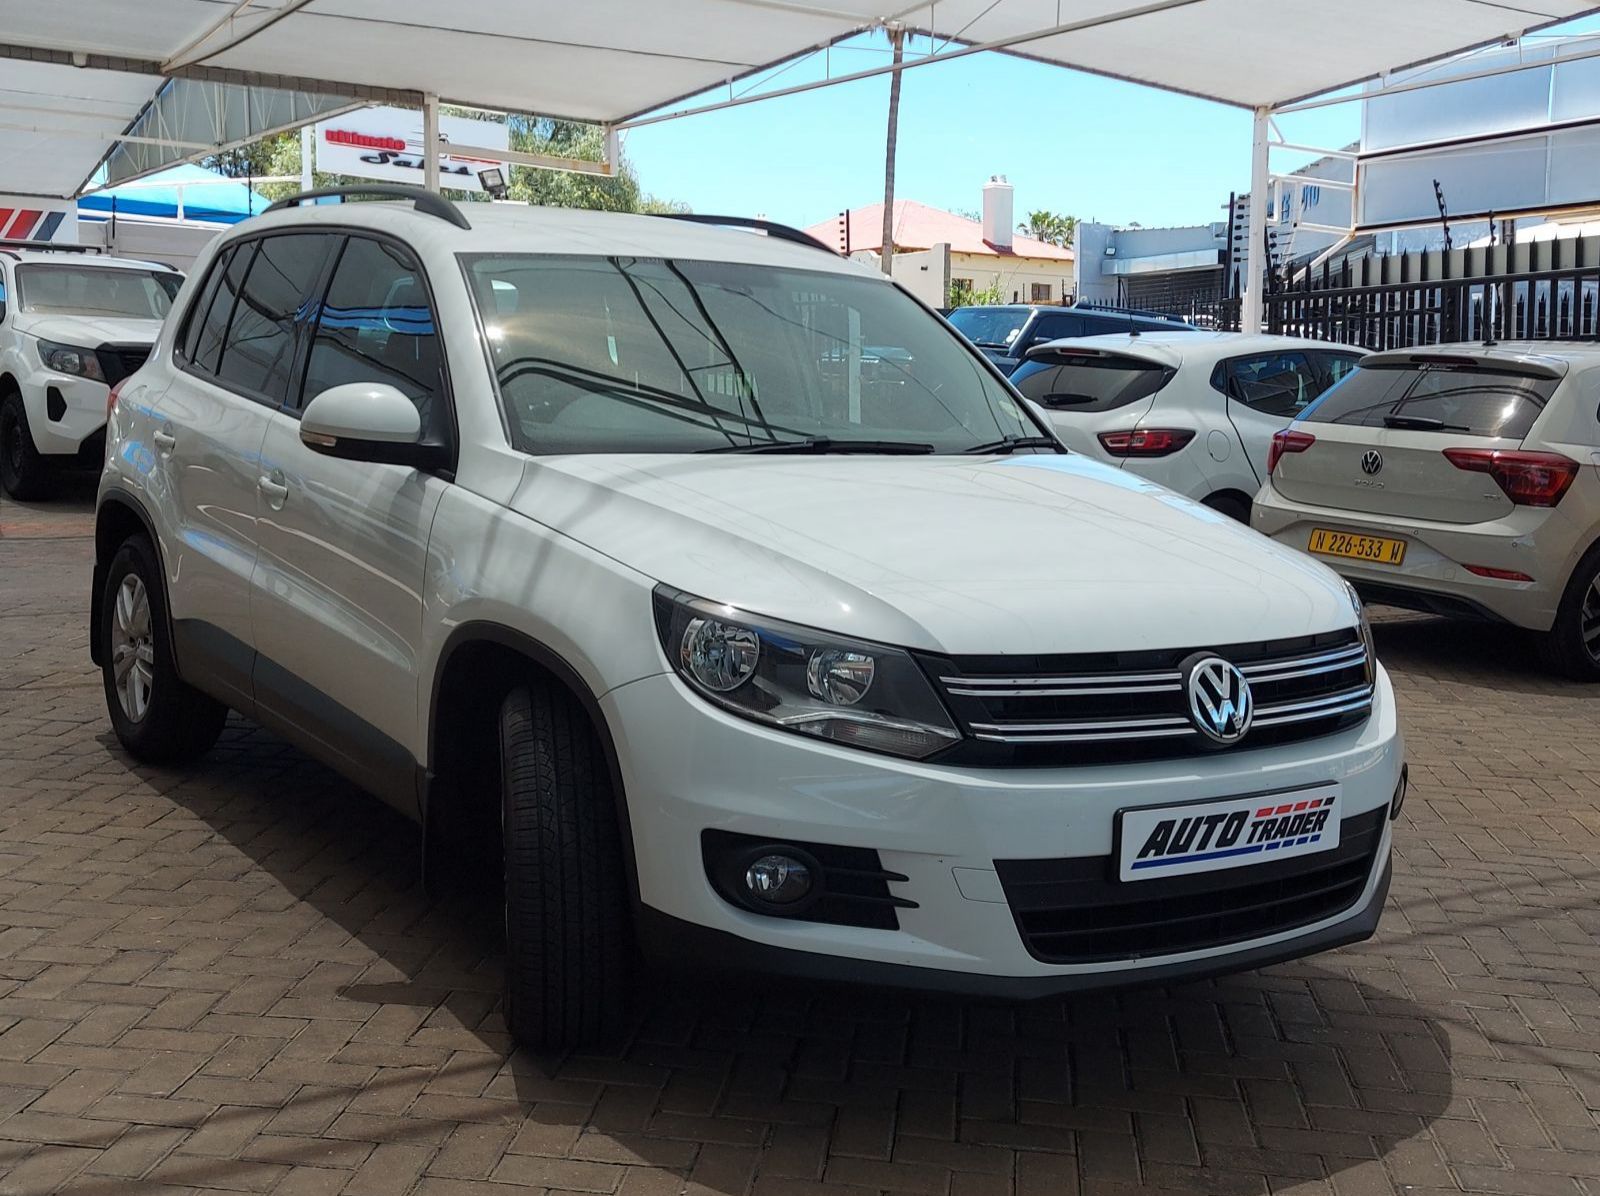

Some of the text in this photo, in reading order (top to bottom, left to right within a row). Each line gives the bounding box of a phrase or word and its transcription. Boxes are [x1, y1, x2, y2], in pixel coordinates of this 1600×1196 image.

[1316, 531, 1326, 549] N
[1328, 534, 1382, 557] 226-533
[1189, 658, 1252, 738] VW
[1136, 809, 1331, 859] AUTO TRADER
